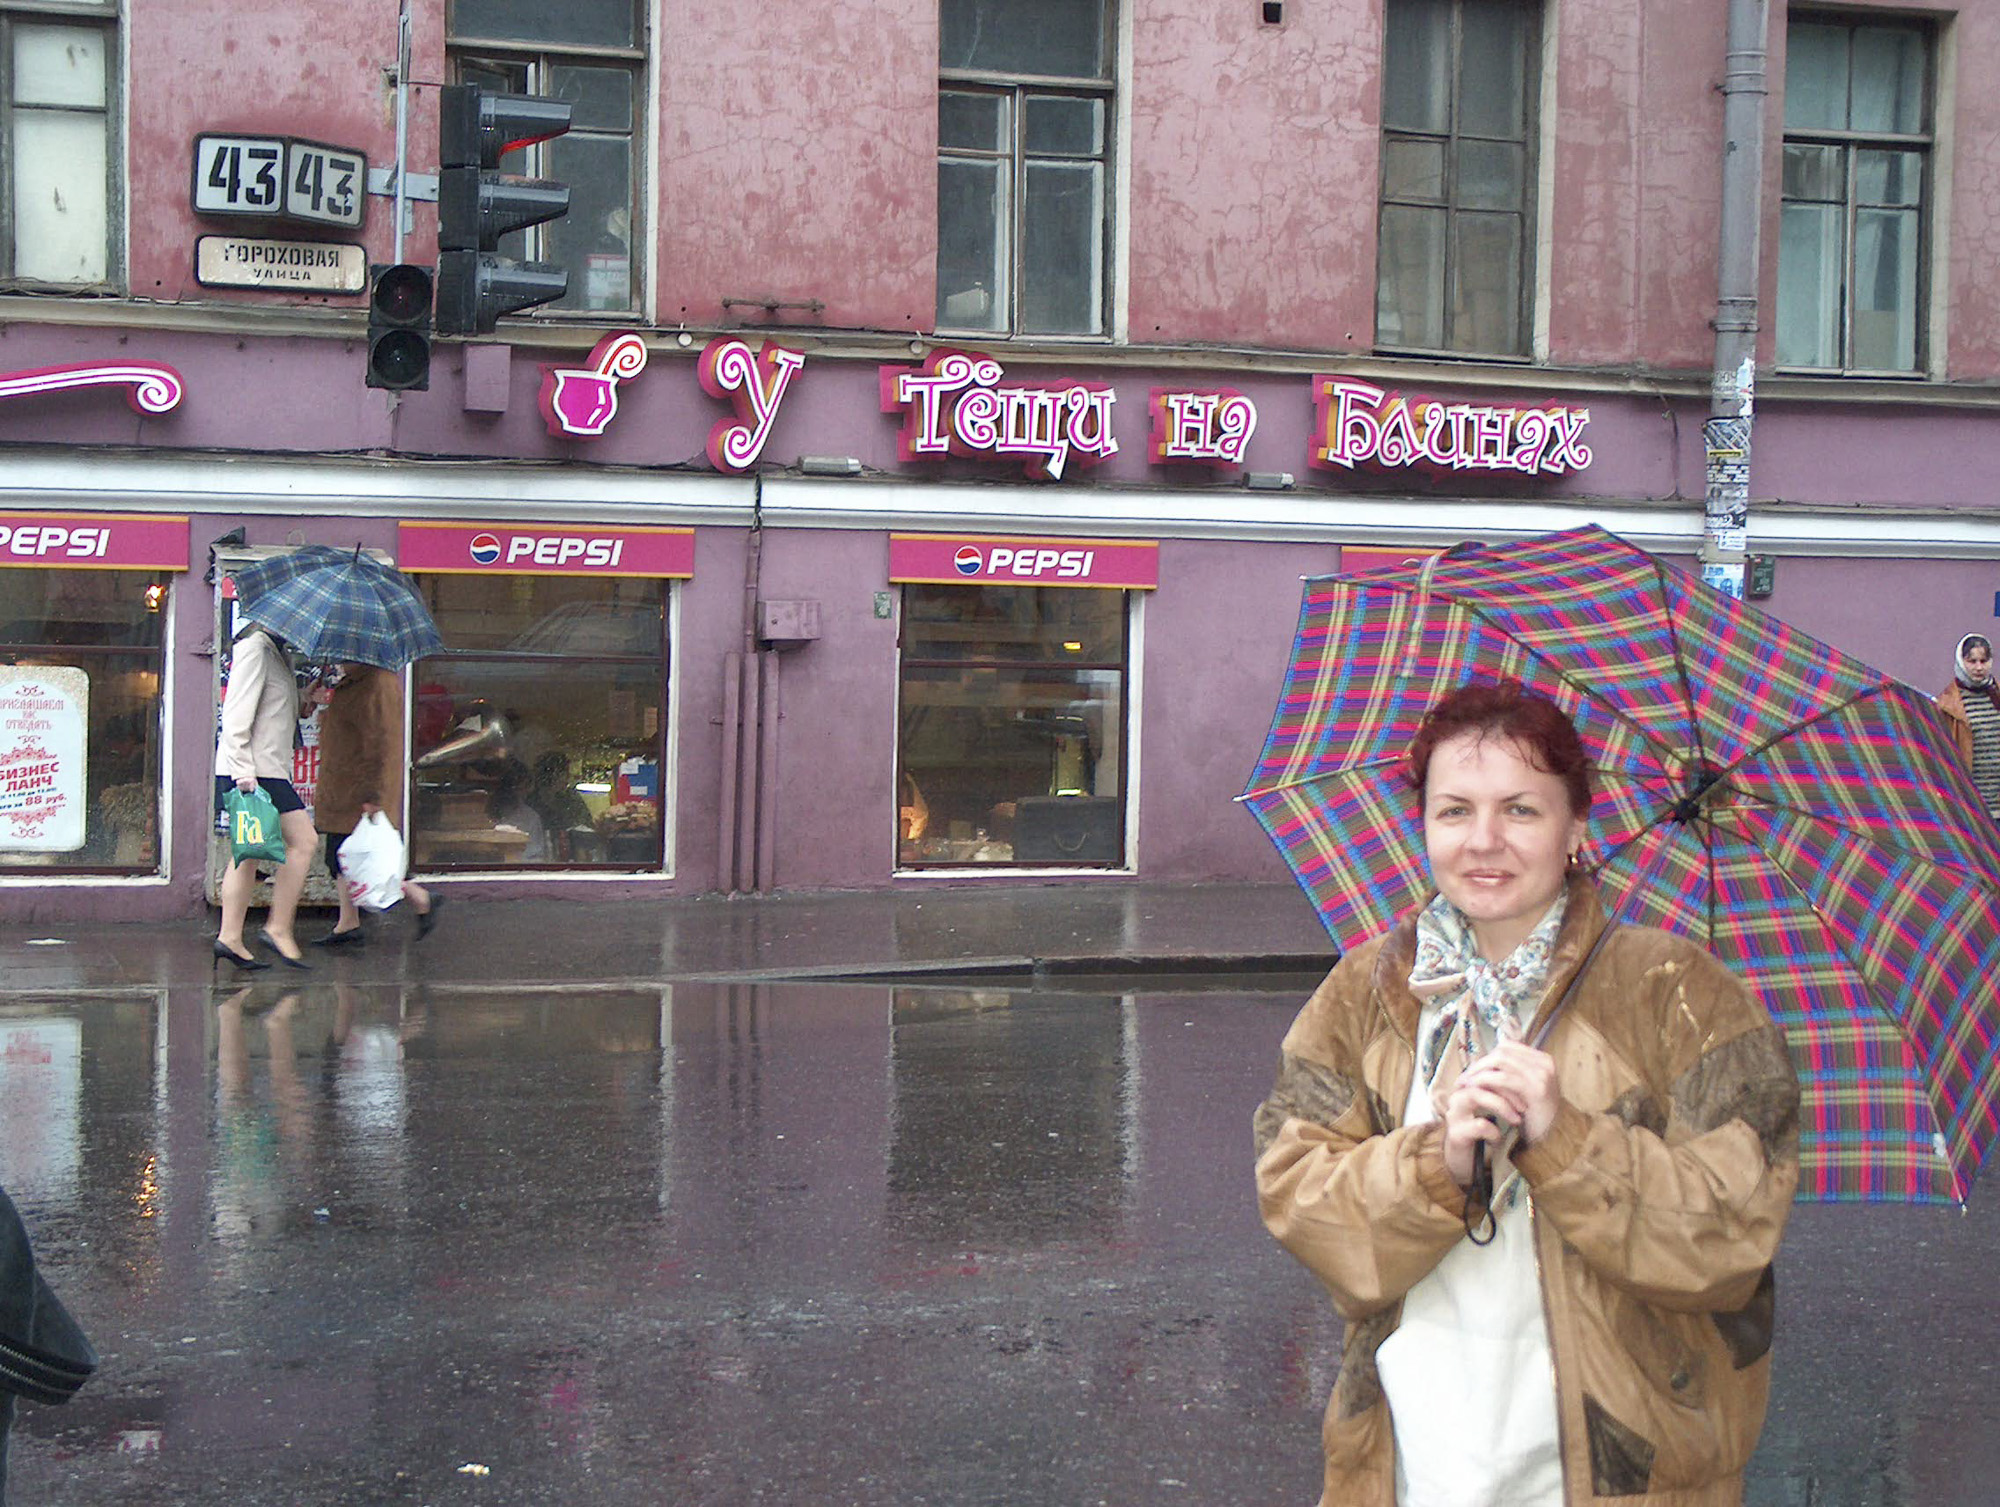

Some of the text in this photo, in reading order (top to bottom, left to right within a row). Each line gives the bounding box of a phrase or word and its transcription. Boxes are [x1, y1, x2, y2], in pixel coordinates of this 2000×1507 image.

[208, 146, 278, 205] 43
[294, 153, 355, 216] 43
[224, 244, 339, 268] ГОРОХОВАЯ
[253, 268, 311, 281] УЛИЦА
[1166, 392, 1258, 464] на
[1327, 382, 1593, 475] Блинах
[506, 536, 624, 567] PEPSI
[987, 548, 1095, 577] PEPSI
[5, 776, 52, 792] ЛАНЧ
[25, 795, 42, 806] 88
[45, 793, 67, 804] руб.
[235, 810, 264, 845] Fa
